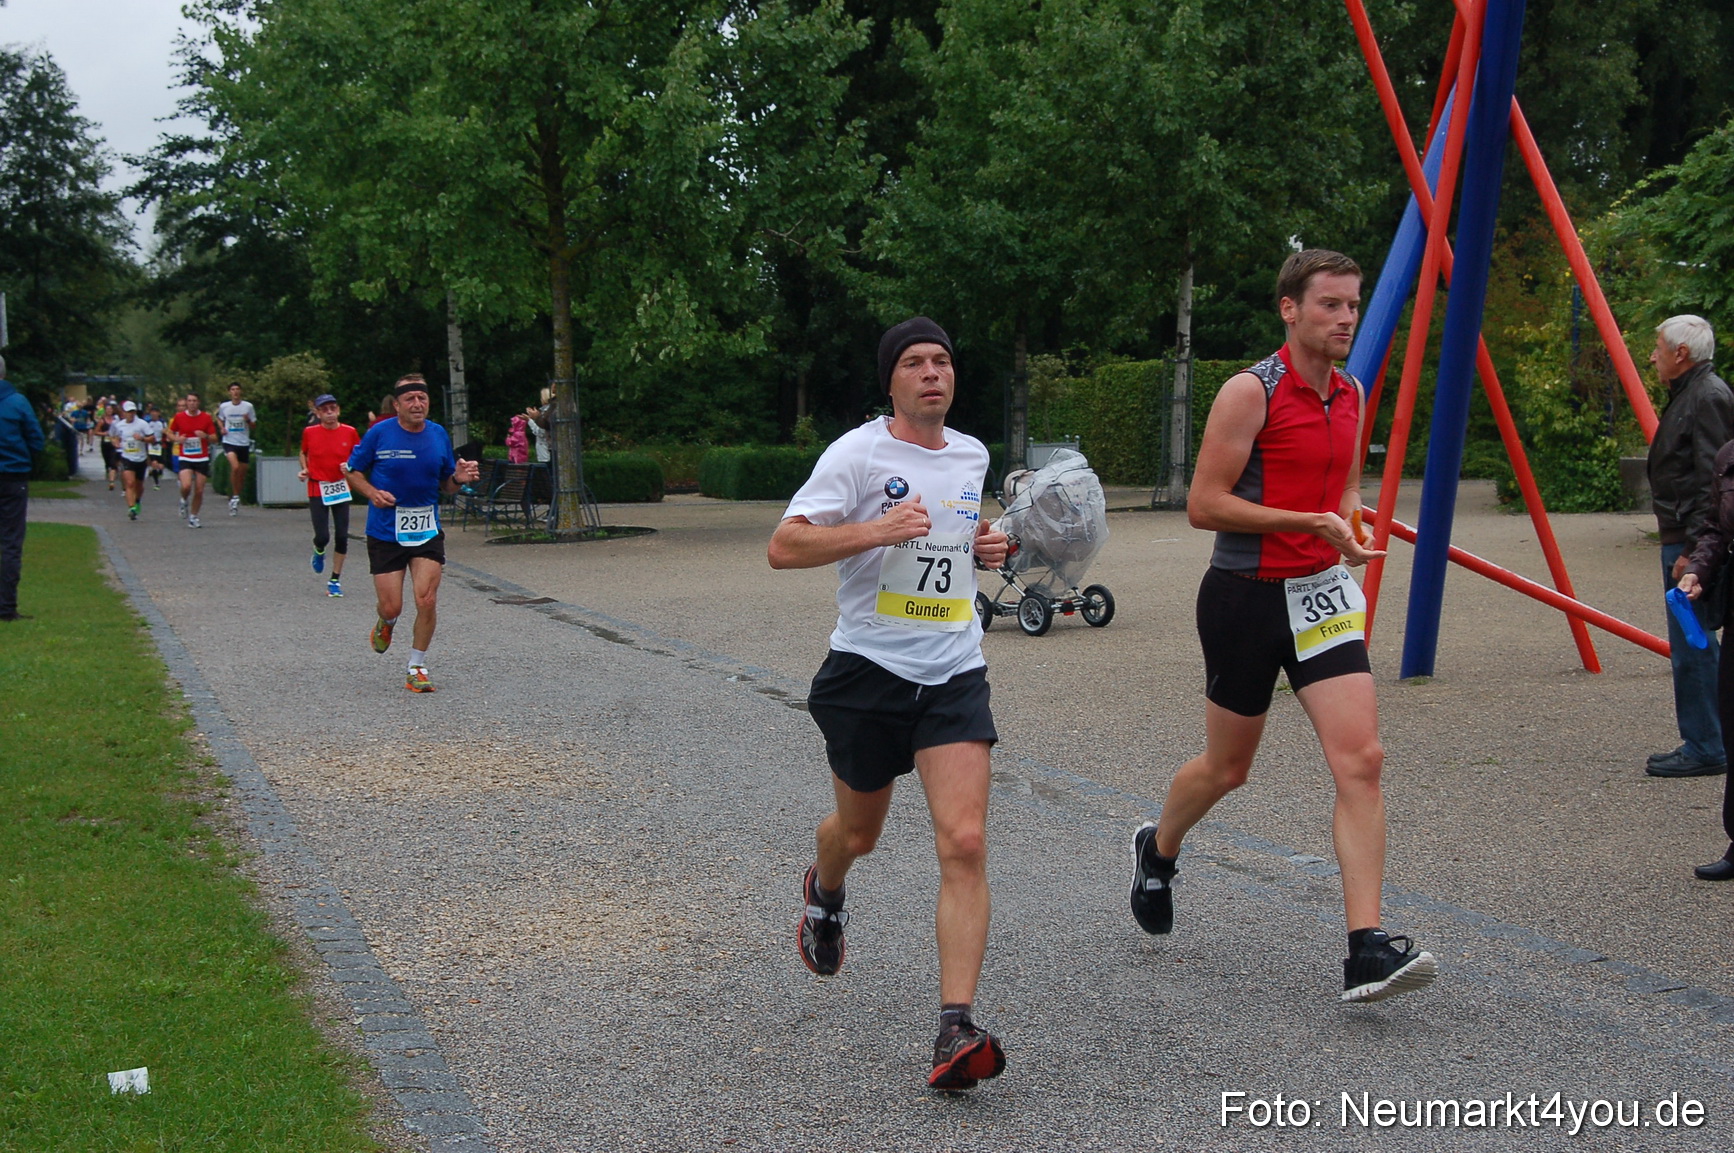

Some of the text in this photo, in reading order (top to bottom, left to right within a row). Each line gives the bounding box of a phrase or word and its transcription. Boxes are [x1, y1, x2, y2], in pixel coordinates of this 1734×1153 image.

[323, 482, 346, 496] 2386
[400, 514, 431, 531] 2371
[894, 540, 962, 552] ARTL Neumarkt
[916, 556, 952, 594] 73
[1287, 584, 1312, 595] PARTL
[905, 600, 951, 618] Gunder
[1301, 584, 1351, 623] 397
[1320, 620, 1354, 638] Franz
